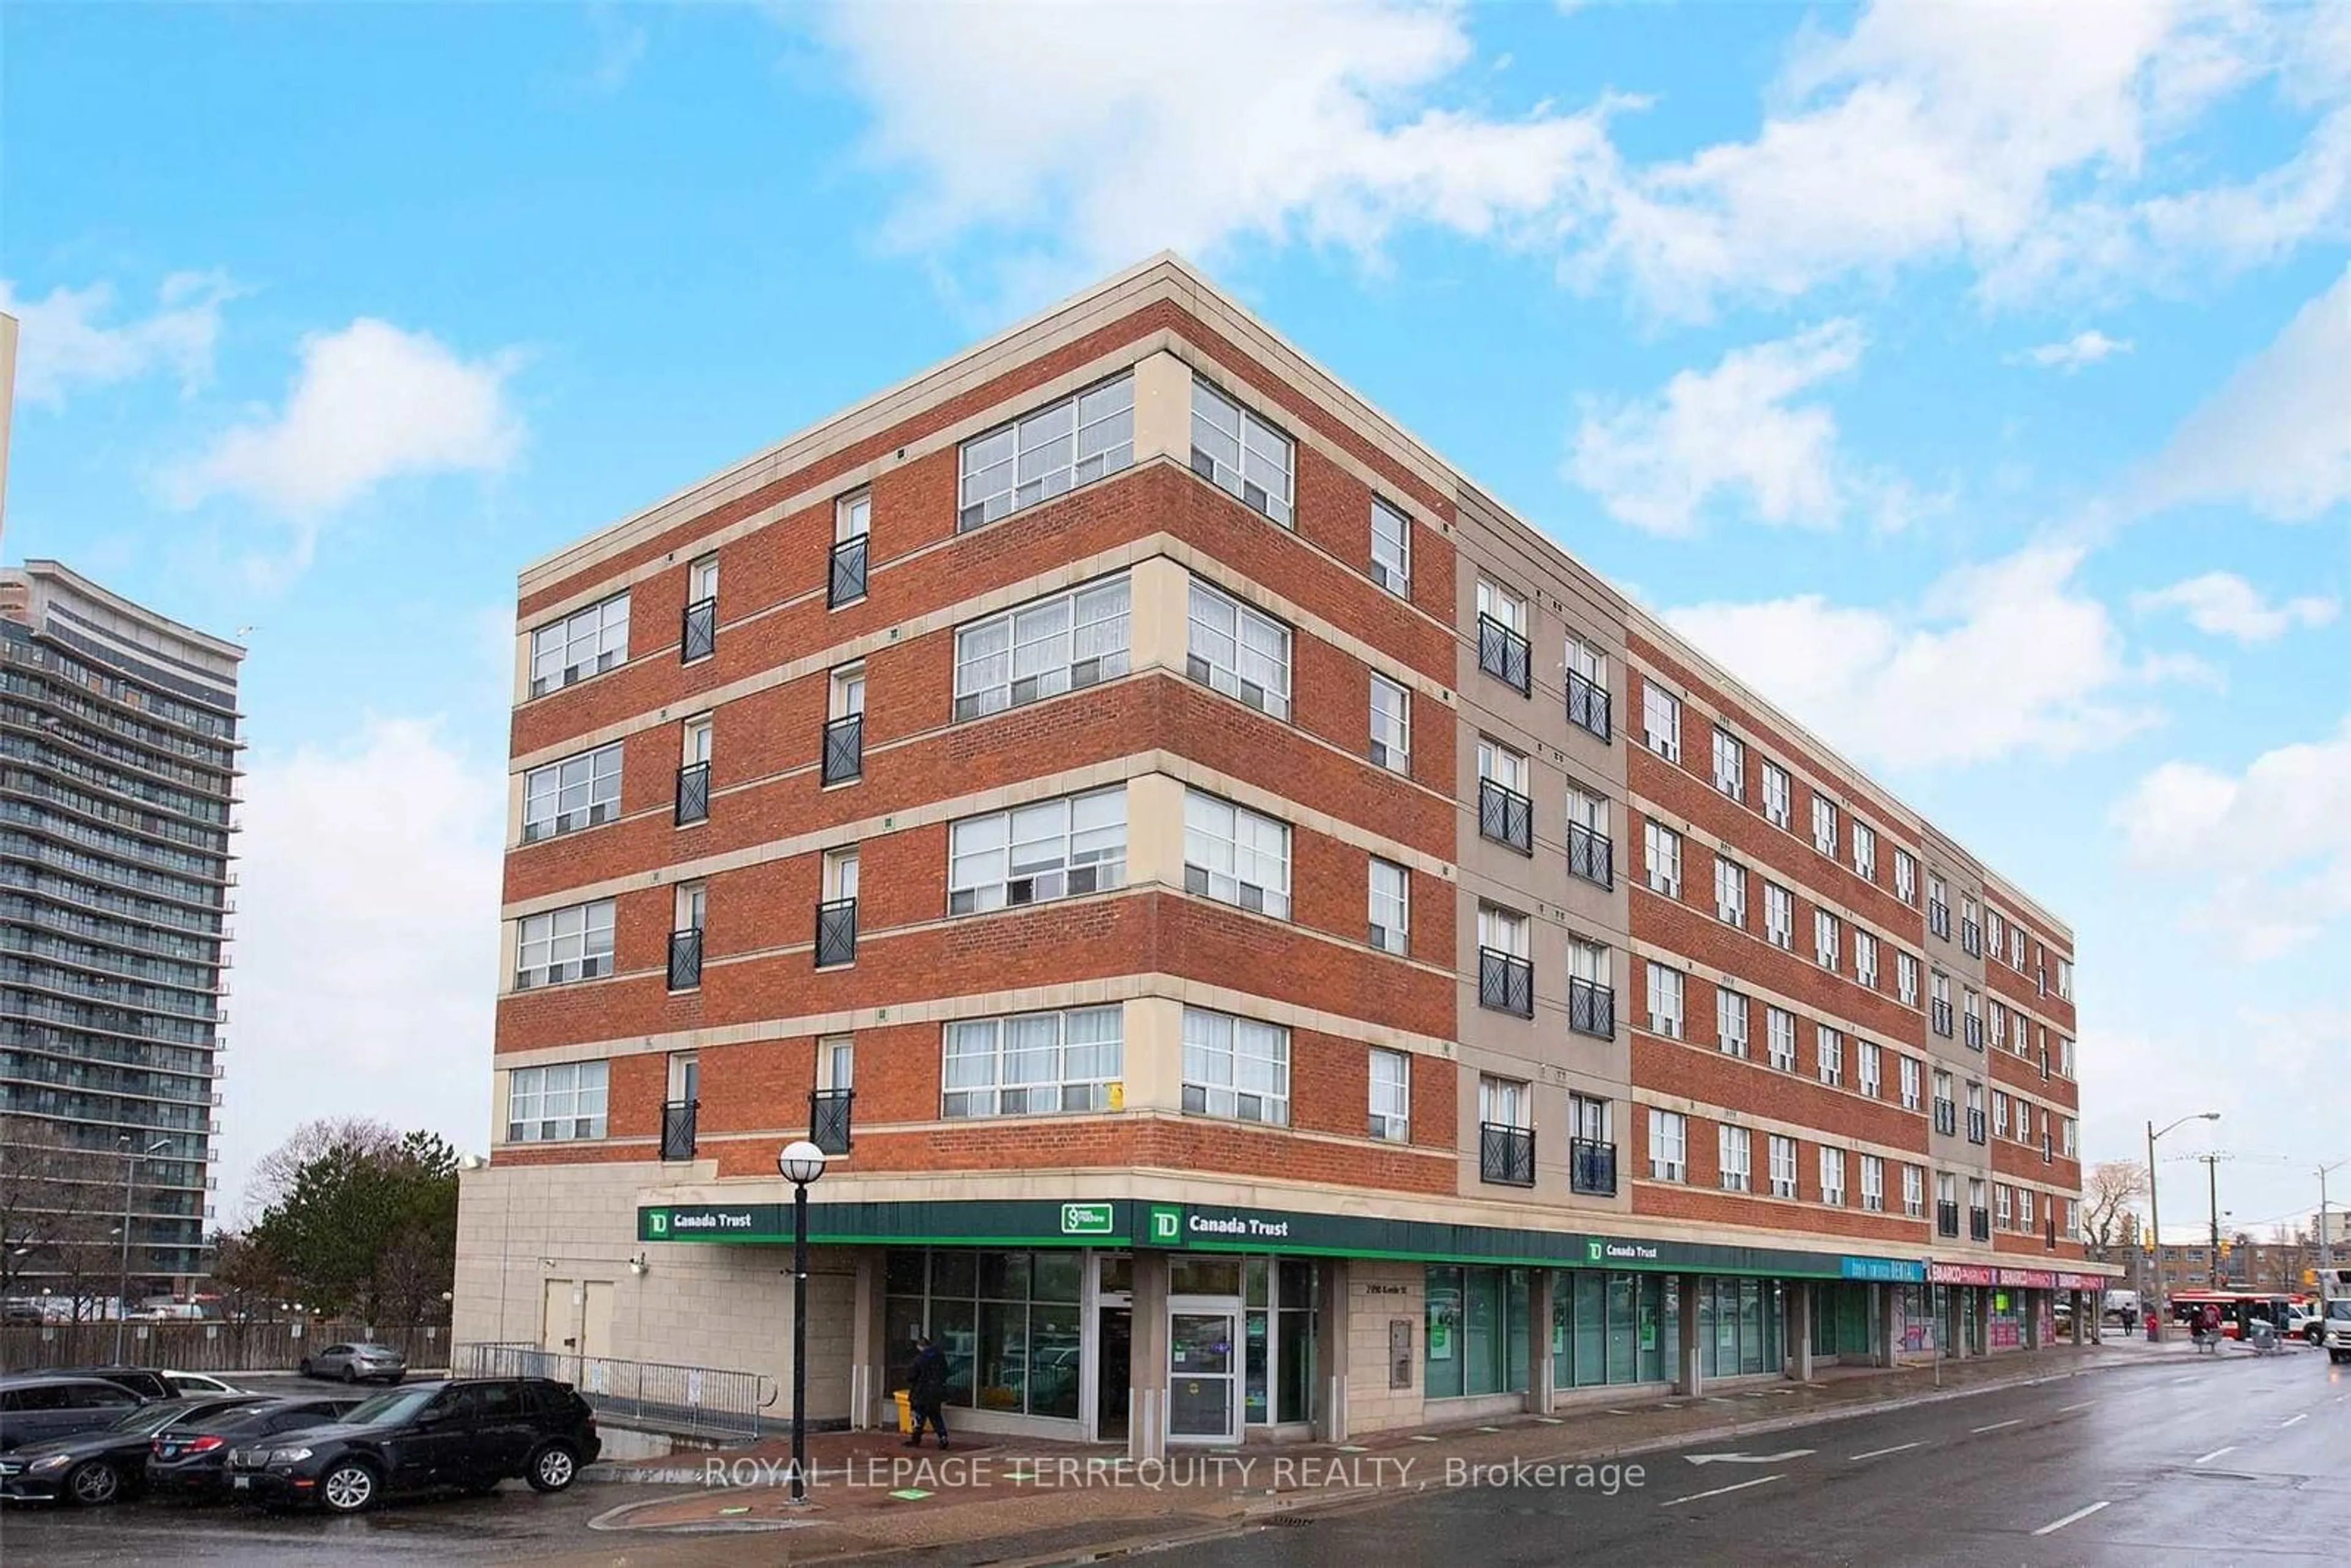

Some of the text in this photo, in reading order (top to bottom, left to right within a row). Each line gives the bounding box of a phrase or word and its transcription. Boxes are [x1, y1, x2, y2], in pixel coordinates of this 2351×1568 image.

[651, 1213, 751, 1232] TD Canada Trust
[1154, 1213, 1288, 1236] TD Canada Trust
[1589, 1242, 1657, 1259] TD Canada Trust
